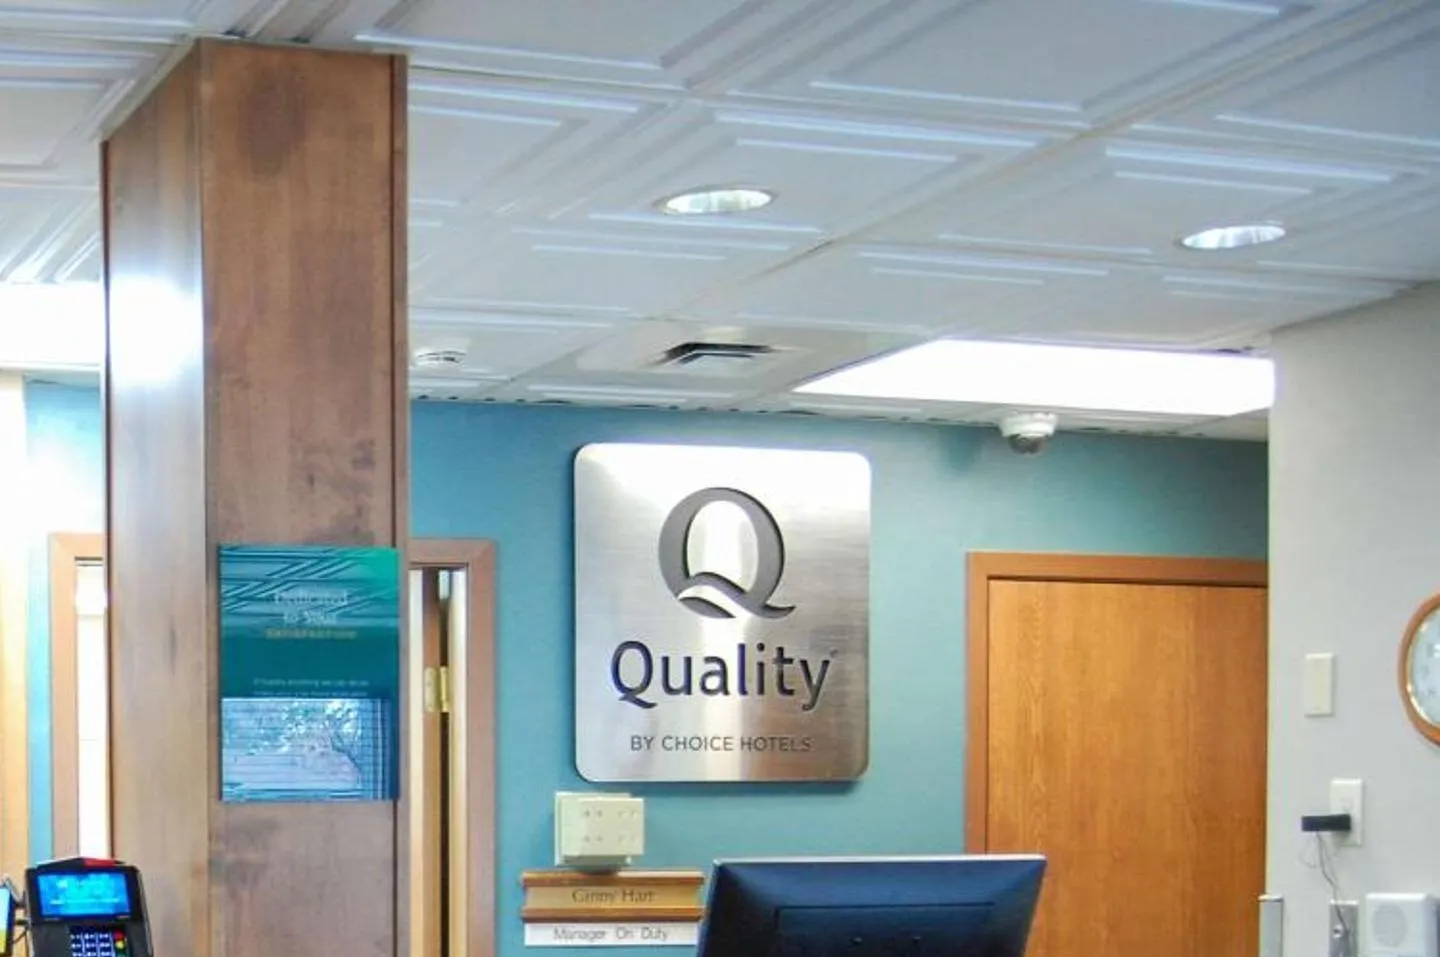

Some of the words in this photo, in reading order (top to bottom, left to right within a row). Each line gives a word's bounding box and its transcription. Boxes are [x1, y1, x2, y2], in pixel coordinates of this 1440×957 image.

[610, 640, 831, 711] Quality
[630, 735, 654, 751] BY
[661, 735, 733, 751] CHOICE
[740, 736, 812, 752] HOTELS
[553, 926, 606, 942] Manager
[615, 926, 634, 940] On
[641, 926, 668, 942] Duty
